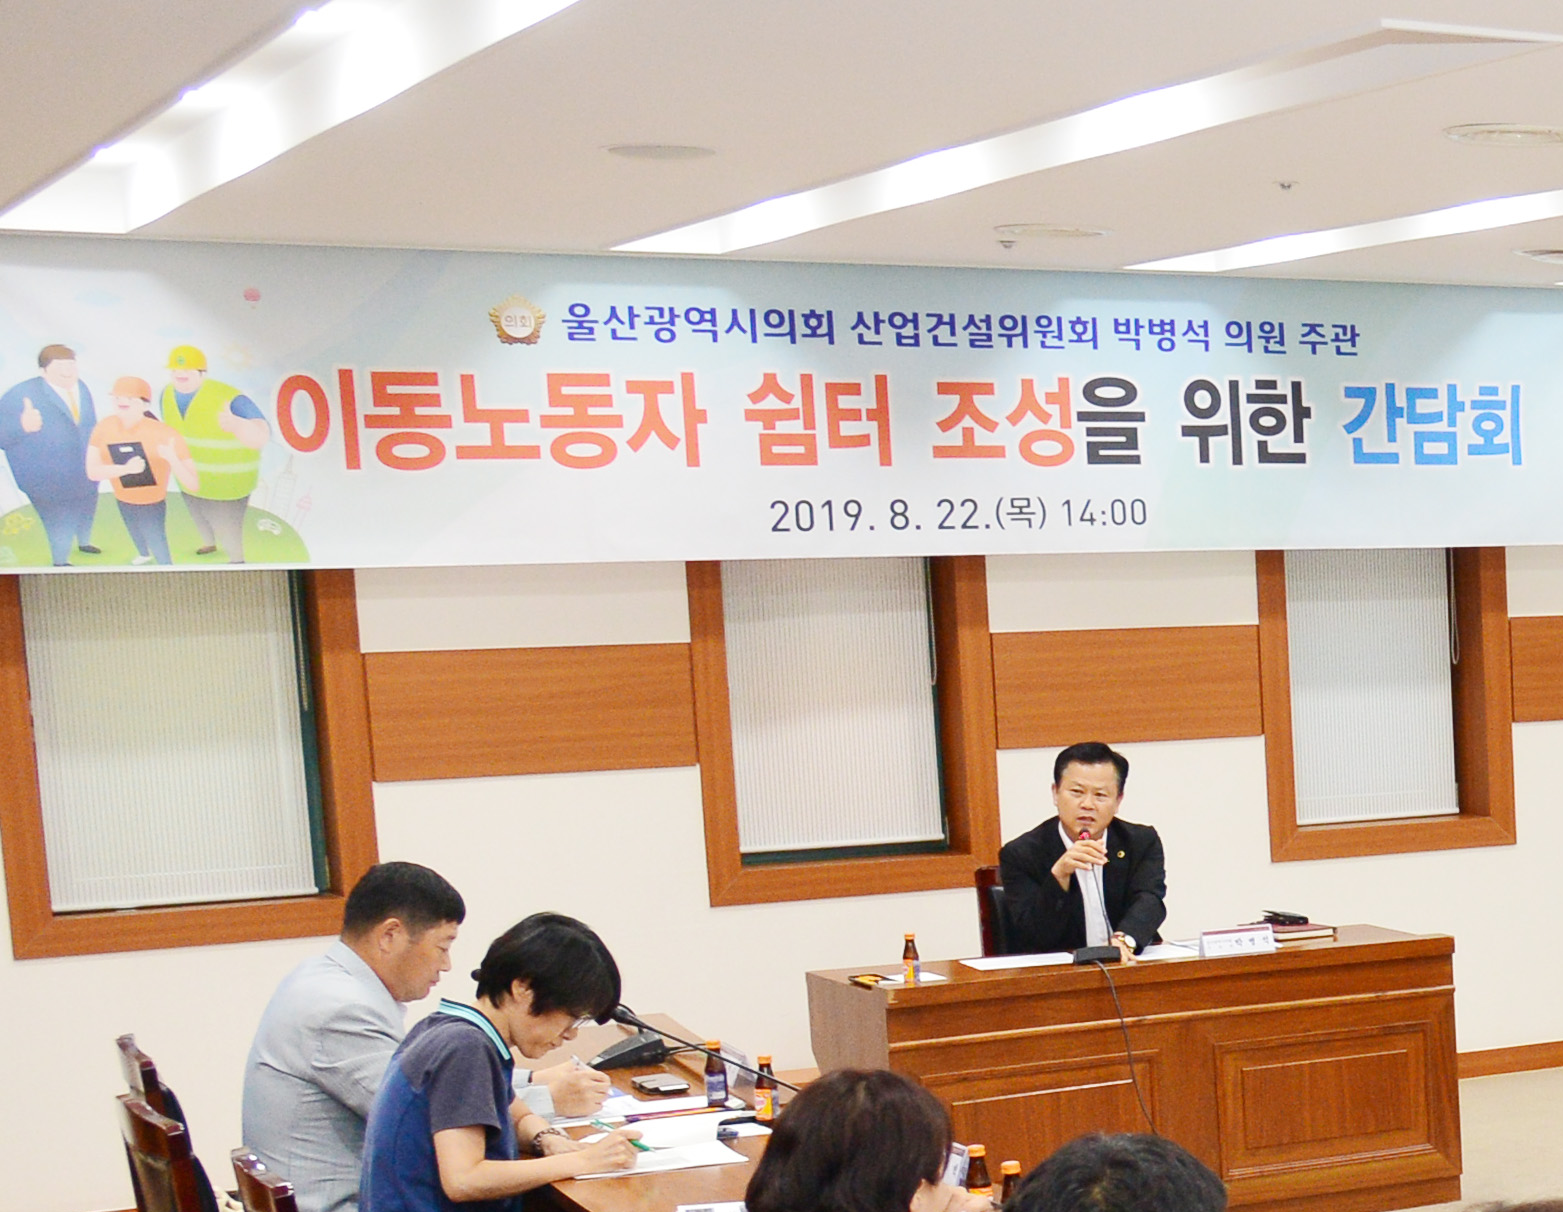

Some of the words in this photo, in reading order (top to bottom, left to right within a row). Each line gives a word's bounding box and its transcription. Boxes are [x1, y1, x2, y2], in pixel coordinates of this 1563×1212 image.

[561, 301, 836, 347] 울산광역시의회
[849, 309, 1099, 351] 산업건설위원회
[1112, 316, 1211, 354] 박병석
[1224, 319, 1288, 356] 의원
[1298, 321, 1362, 358] 주관
[276, 366, 707, 472] 이동노동자
[743, 372, 893, 468] 쉼터
[931, 375, 1147, 468] 조성을
[1180, 377, 1313, 467] 위한
[1341, 382, 1523, 467] 간담회
[769, 498, 876, 533] 2019.
[889, 498, 922, 532] 8.
[1061, 498, 1148, 528] 14:00
